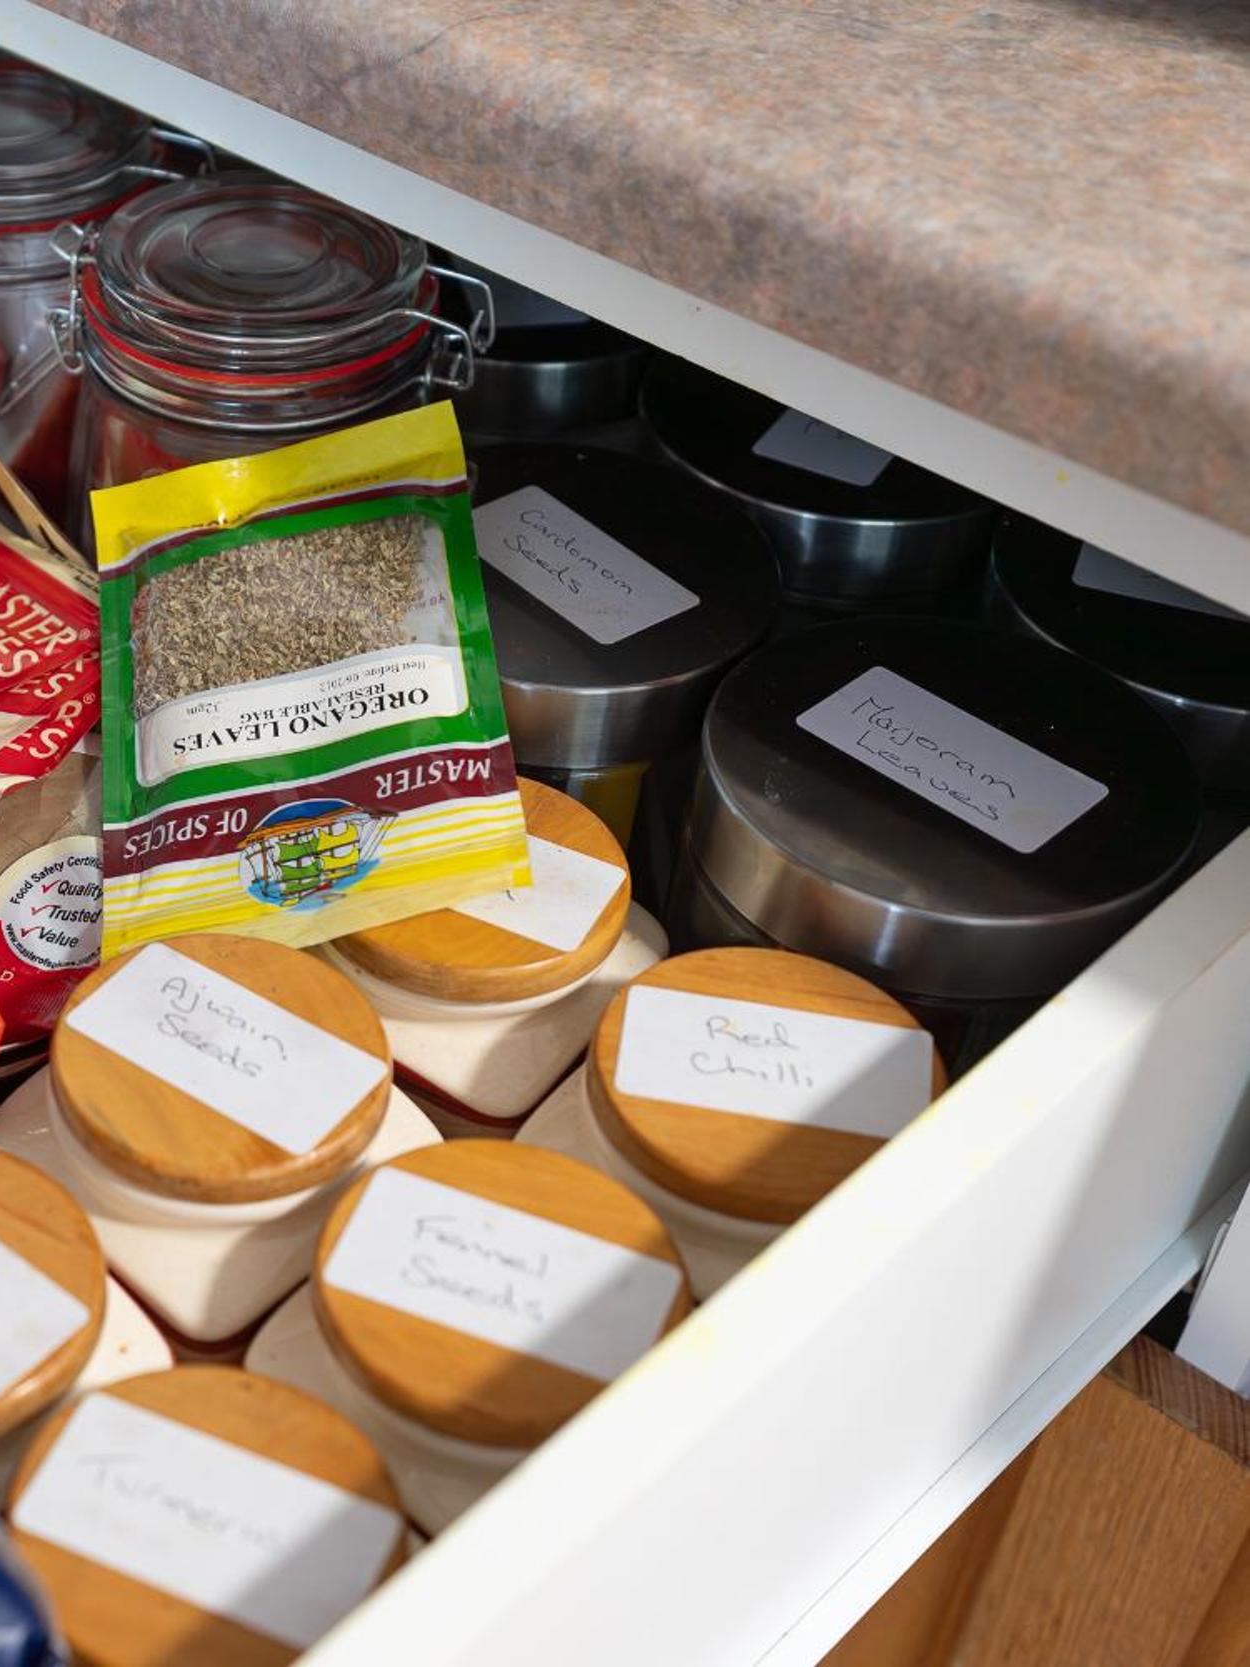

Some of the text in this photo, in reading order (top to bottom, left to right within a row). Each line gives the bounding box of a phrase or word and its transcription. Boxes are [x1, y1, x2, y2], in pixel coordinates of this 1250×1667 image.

[502, 534, 581, 595] Seeds
[173, 687, 429, 755] OREGANO LEAVES
[240, 683, 385, 724] RESEALABLE BAG
[851, 697, 1015, 798] Marjoram
[374, 757, 492, 799] MASTER
[856, 730, 999, 821] Leaves
[123, 807, 248, 860] OF SPICES
[10, 880, 34, 905] Food
[30, 861, 64, 884] Safety
[57, 879, 104, 901] Quality
[47, 904, 103, 924] Trusted
[38, 926, 79, 948] Value
[157, 1013, 263, 1078] Seeds
[706, 1014, 799, 1051] Red
[689, 1050, 814, 1088] Chilli
